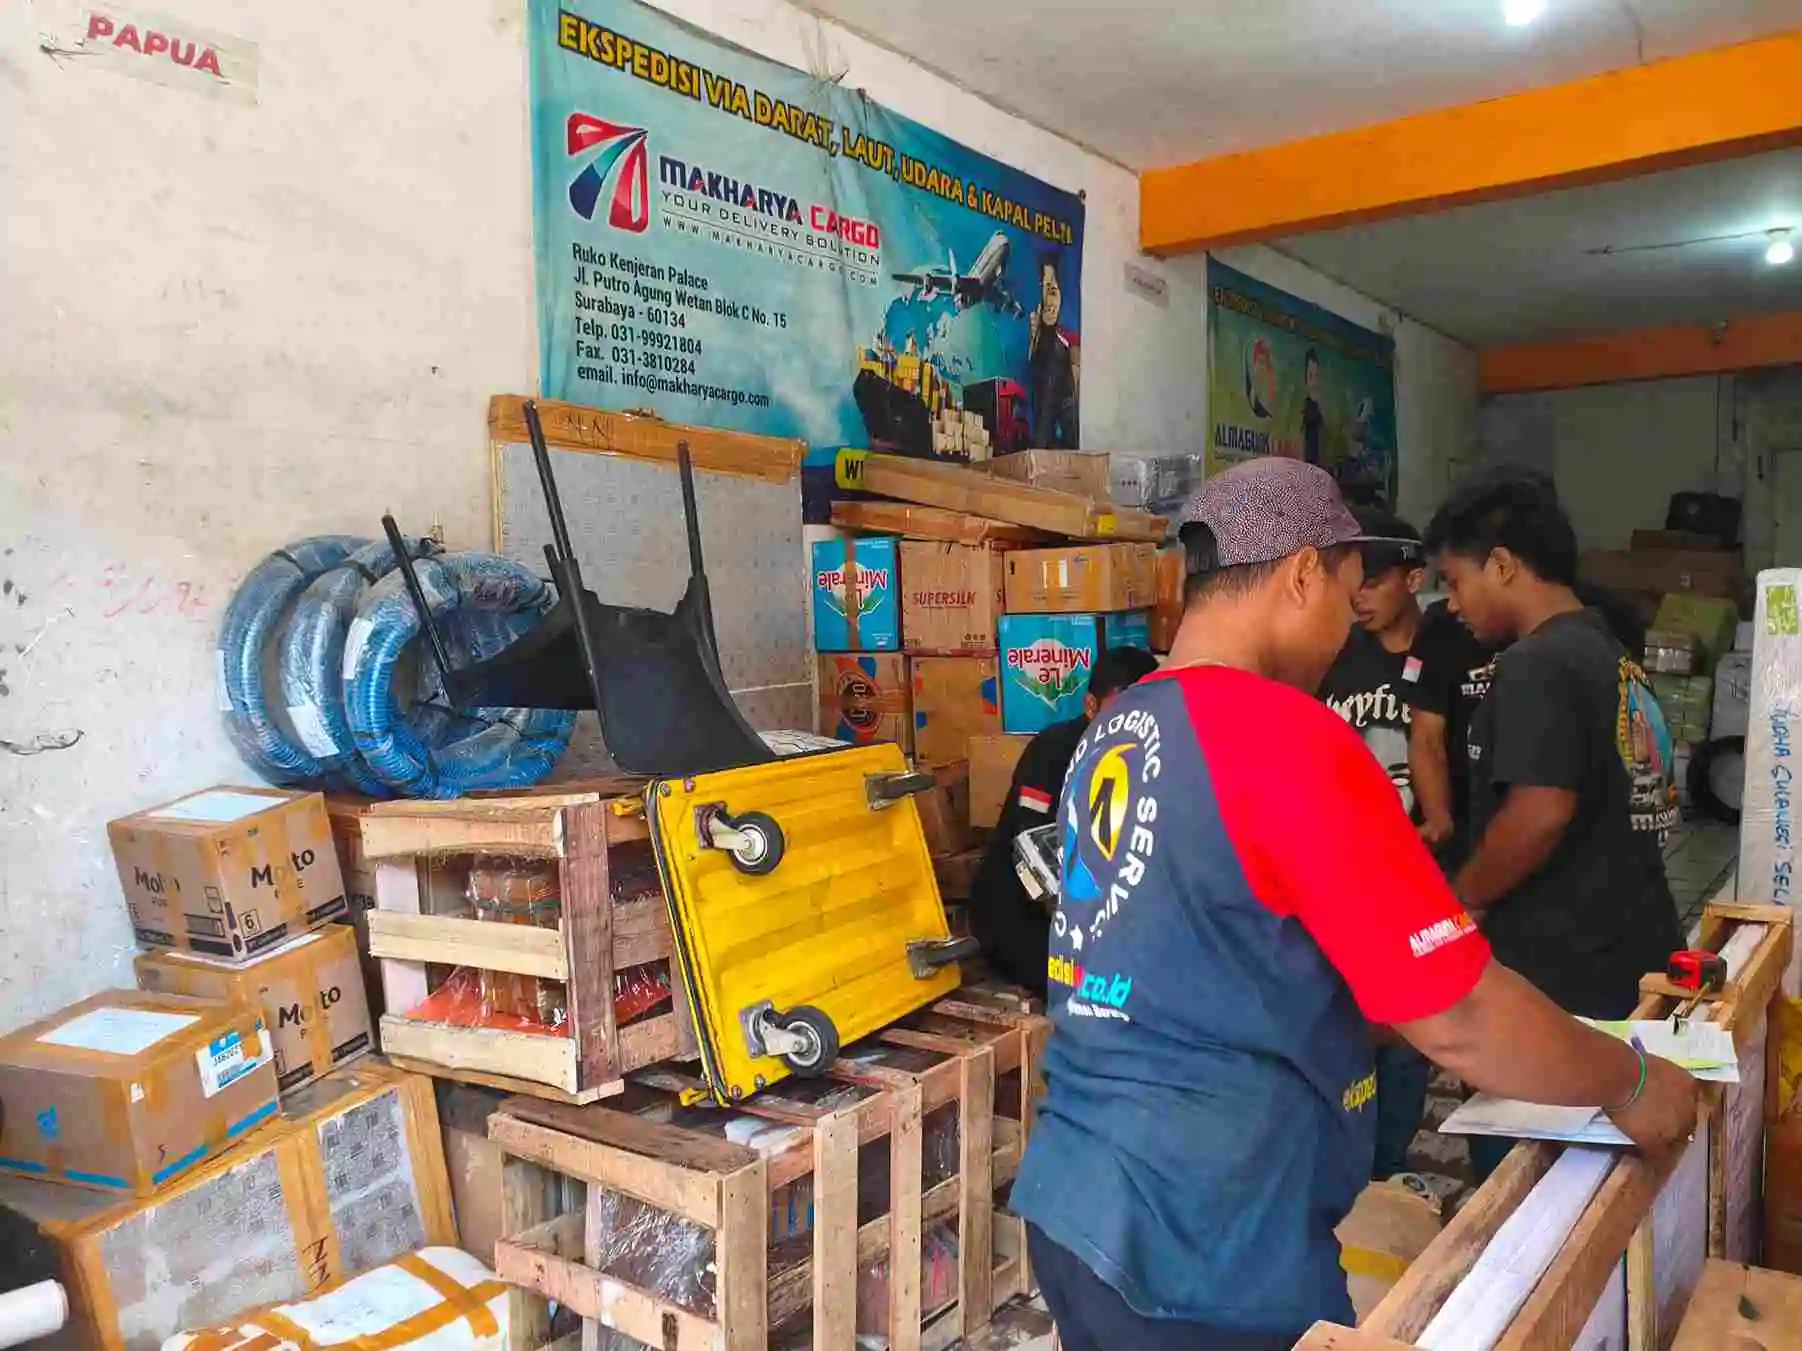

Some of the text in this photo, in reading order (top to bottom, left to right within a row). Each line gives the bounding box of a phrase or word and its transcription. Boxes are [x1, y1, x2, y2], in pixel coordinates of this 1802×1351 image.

[87, 15, 224, 78] PAPUA
[559, 12, 701, 100] EKSPEDISI
[703, 68, 752, 121] VIA
[754, 90, 838, 157] DARAT,
[842, 126, 900, 182] LAUT,
[902, 153, 963, 207] UDARA
[966, 182, 978, 210] &
[981, 188, 1032, 231] KAPAL
[660, 155, 880, 249] MAKHARYA CARGO
[661, 190, 881, 266] YOUR DELIVERY SOLUTION
[572, 243, 708, 290] Ruko Kenjeran Palace
[574, 266, 787, 328] Jl. Putro Agung Wetan Blok C No. 15
[575, 292, 635, 321] Surabaya
[647, 307, 686, 328] 60134
[576, 317, 702, 355] Telp. 031-99921804
[576, 340, 696, 375] Fax. 031-3810284
[577, 365, 770, 408] email. info@makharyacargo.com
[817, 568, 889, 592] Minrale
[1007, 647, 1092, 669] Minerale
[1038, 667, 1061, 688] Le
[1094, 710, 1161, 783] LOGISTIC
[245, 914, 255, 931] 6
[279, 986, 341, 1029] Moto
